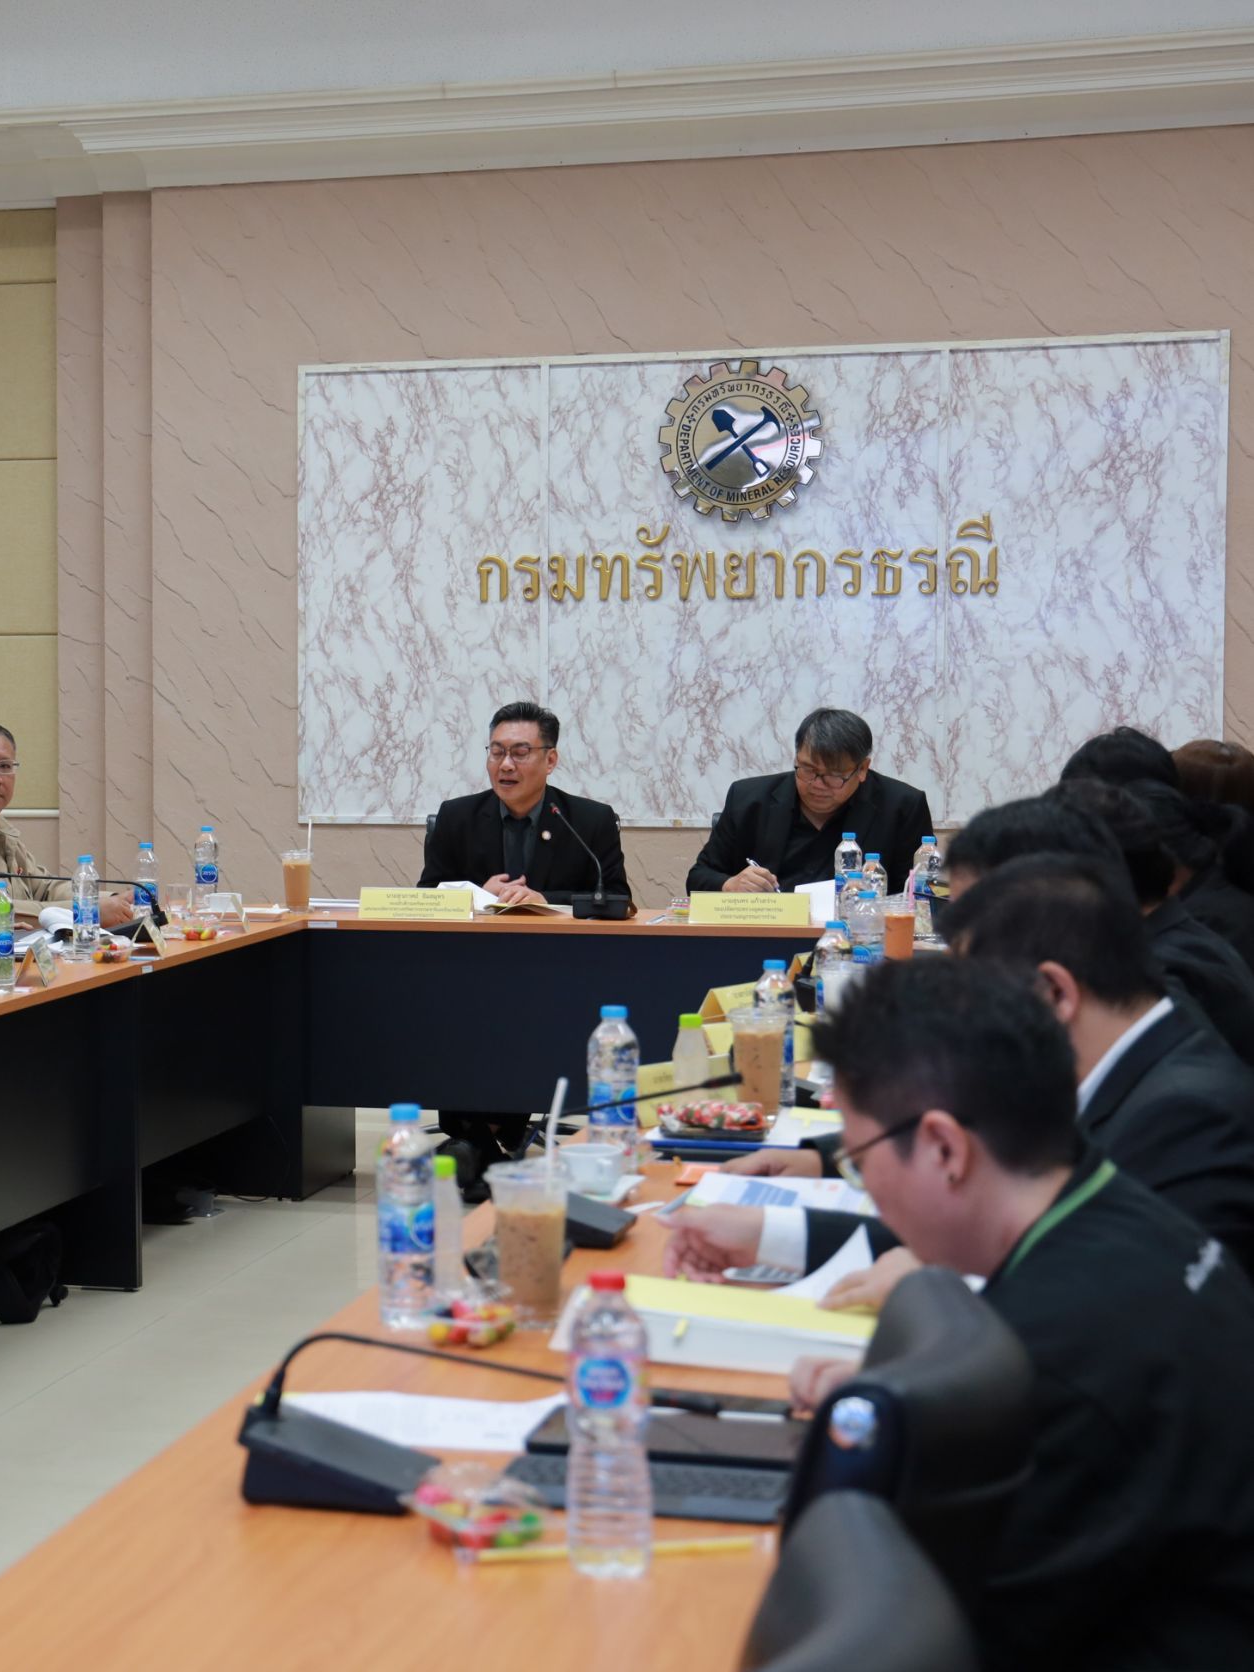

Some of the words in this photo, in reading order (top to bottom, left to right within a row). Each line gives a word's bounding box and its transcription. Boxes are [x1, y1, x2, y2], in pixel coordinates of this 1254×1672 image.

[679, 423, 711, 492] DEPARTMENT
[709, 485, 724, 500] OF
[726, 483, 775, 502] MINERAL
[773, 423, 801, 487] RESOURCES
[476, 512, 1000, 601] กรมทรัพยากรธรณี
